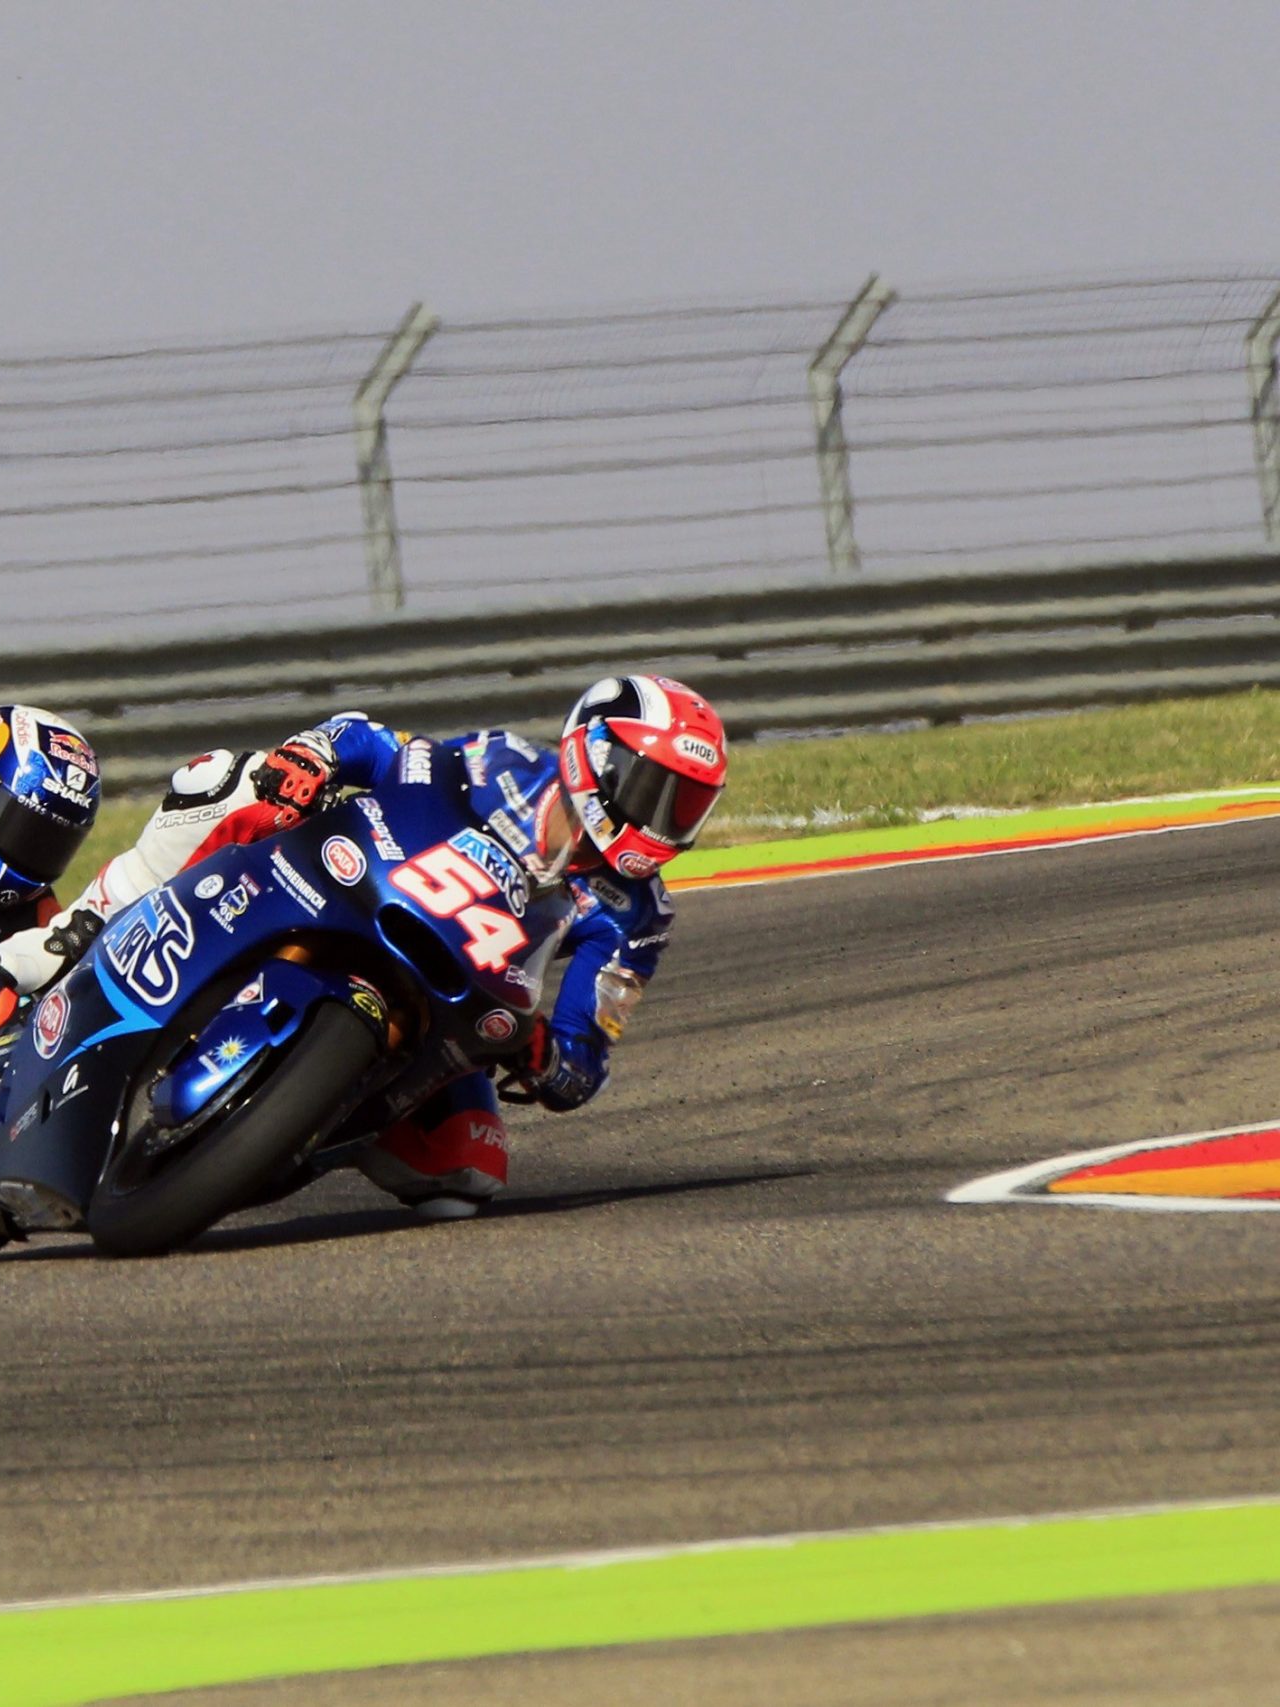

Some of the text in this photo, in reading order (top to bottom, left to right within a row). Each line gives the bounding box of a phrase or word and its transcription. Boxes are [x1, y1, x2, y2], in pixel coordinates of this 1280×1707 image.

[682, 739, 716, 761] SHOEI
[42, 777, 93, 810] SHARK
[155, 803, 228, 829] VIRCOS
[270, 850, 327, 910] JUNGHEINRICH
[388, 842, 529, 974] 54
